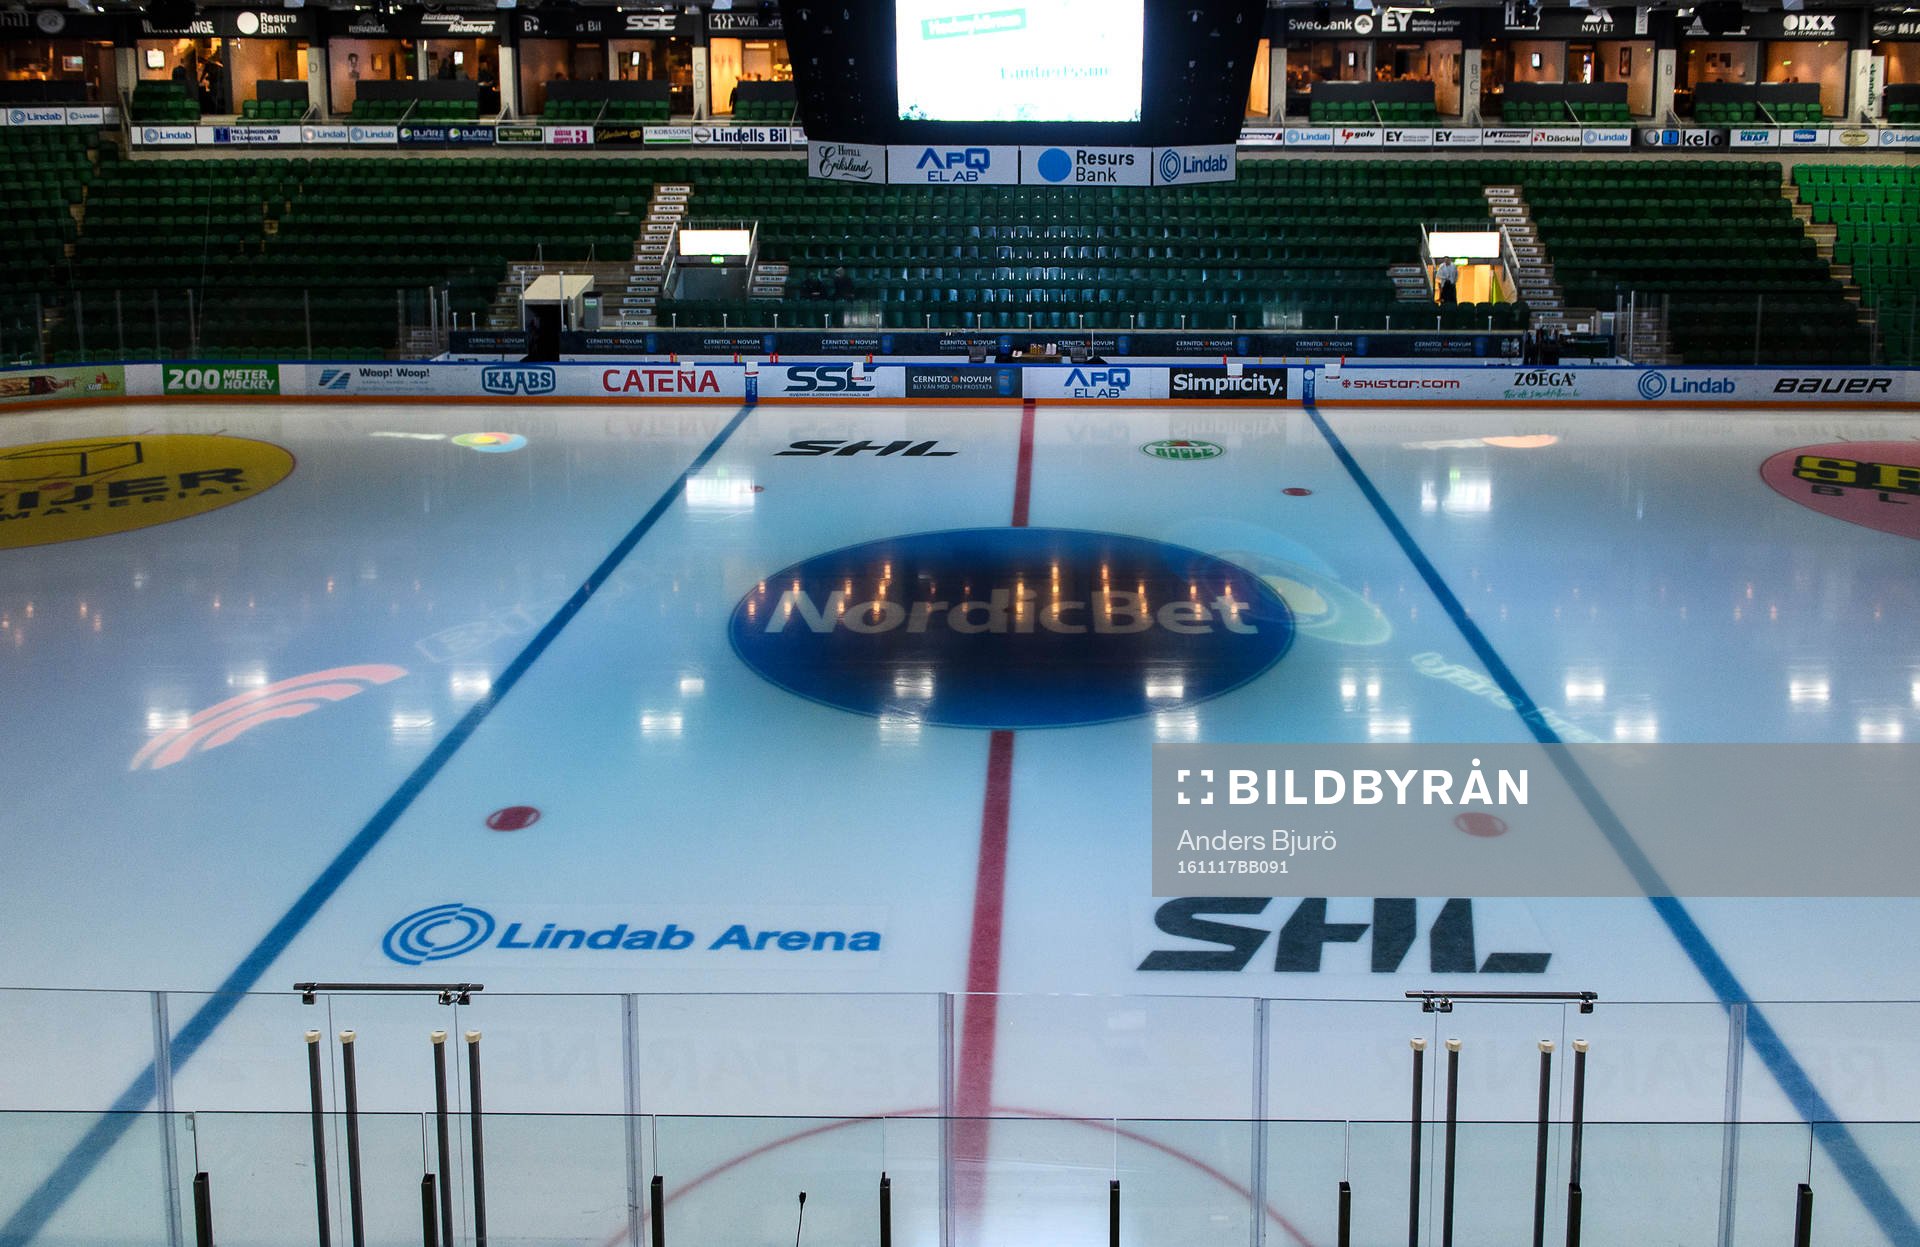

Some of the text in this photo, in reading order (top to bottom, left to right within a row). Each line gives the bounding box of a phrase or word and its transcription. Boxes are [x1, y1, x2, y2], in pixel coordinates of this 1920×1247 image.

[260, 12, 297, 24] Resurs
[625, 15, 677, 31] SSE
[1381, 12, 1412, 32] EY
[260, 23, 288, 34] Bank
[1581, 23, 1615, 34] NAVET
[27, 112, 62, 121] Lindab
[159, 131, 192, 140] Lindab
[317, 128, 346, 139] Lindab
[365, 128, 394, 139] Lindab
[712, 128, 765, 142] Lindells
[769, 128, 787, 142] Bil
[1301, 131, 1331, 141] Lindab
[1386, 131, 1402, 142] EY
[1435, 131, 1452, 142] EY
[1547, 134, 1580, 142] Däckia
[1598, 132, 1628, 142] Lindab
[1682, 130, 1723, 146] kelo
[1076, 149, 1135, 166] Resurs
[1184, 155, 1228, 174] Lindab
[928, 171, 979, 182] EL AB
[1076, 166, 1118, 184] Bank
[167, 369, 268, 390] 200 METER
[359, 367, 430, 380] Woop! Woop!
[487, 368, 551, 389] KAABS
[912, 375, 992, 384] CERNITOL NOVUM
[223, 379, 276, 390] HOCKEY
[602, 369, 720, 393] CATENA
[1670, 377, 1736, 394] Lindab
[1074, 388, 1120, 398] EL AB
[773, 440, 959, 457] SHL
[764, 587, 1259, 635] NordicBet
[496, 922, 883, 952] Lindab Arena
[1136, 896, 1553, 973] SHL
